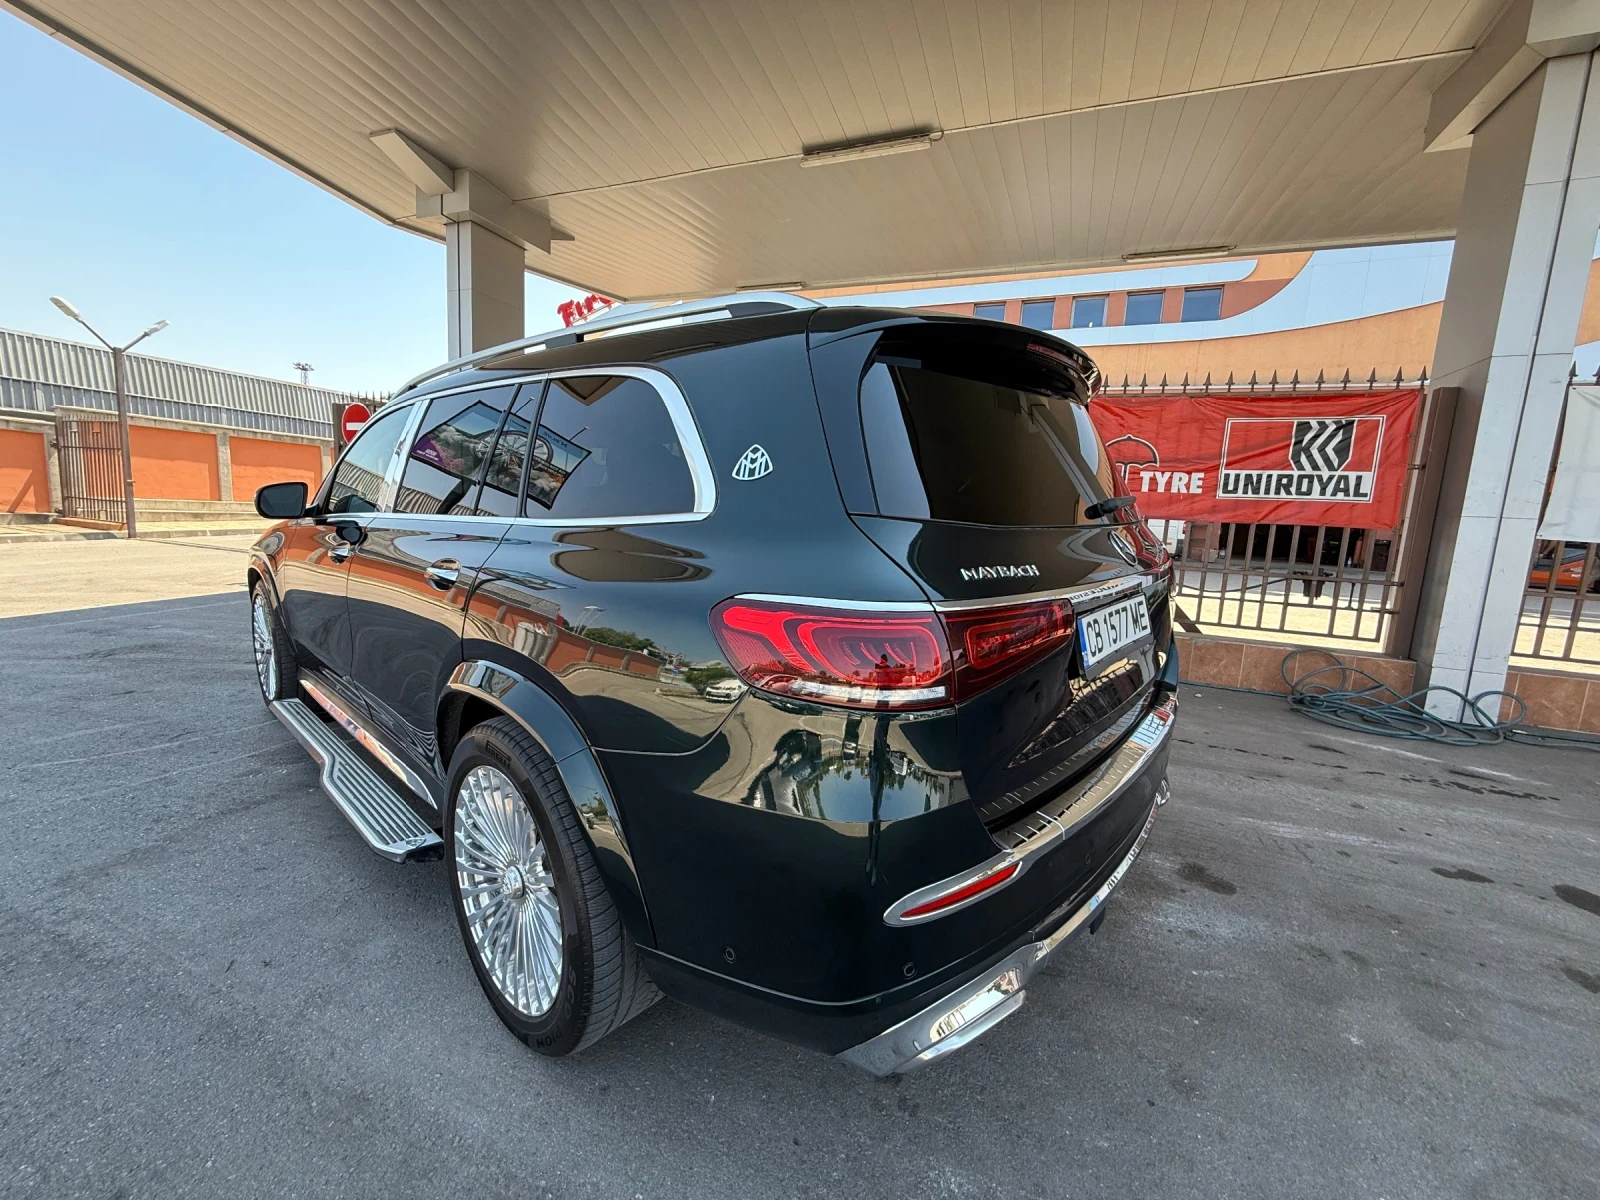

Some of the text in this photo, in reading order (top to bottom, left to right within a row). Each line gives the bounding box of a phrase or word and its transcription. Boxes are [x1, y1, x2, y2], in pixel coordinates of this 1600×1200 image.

[1140, 471, 1204, 493] TYRE
[1222, 473, 1368, 497] UNIROYAL
[960, 564, 1040, 581] MAYBACH
[1086, 601, 1148, 658] CB 1577 ME
